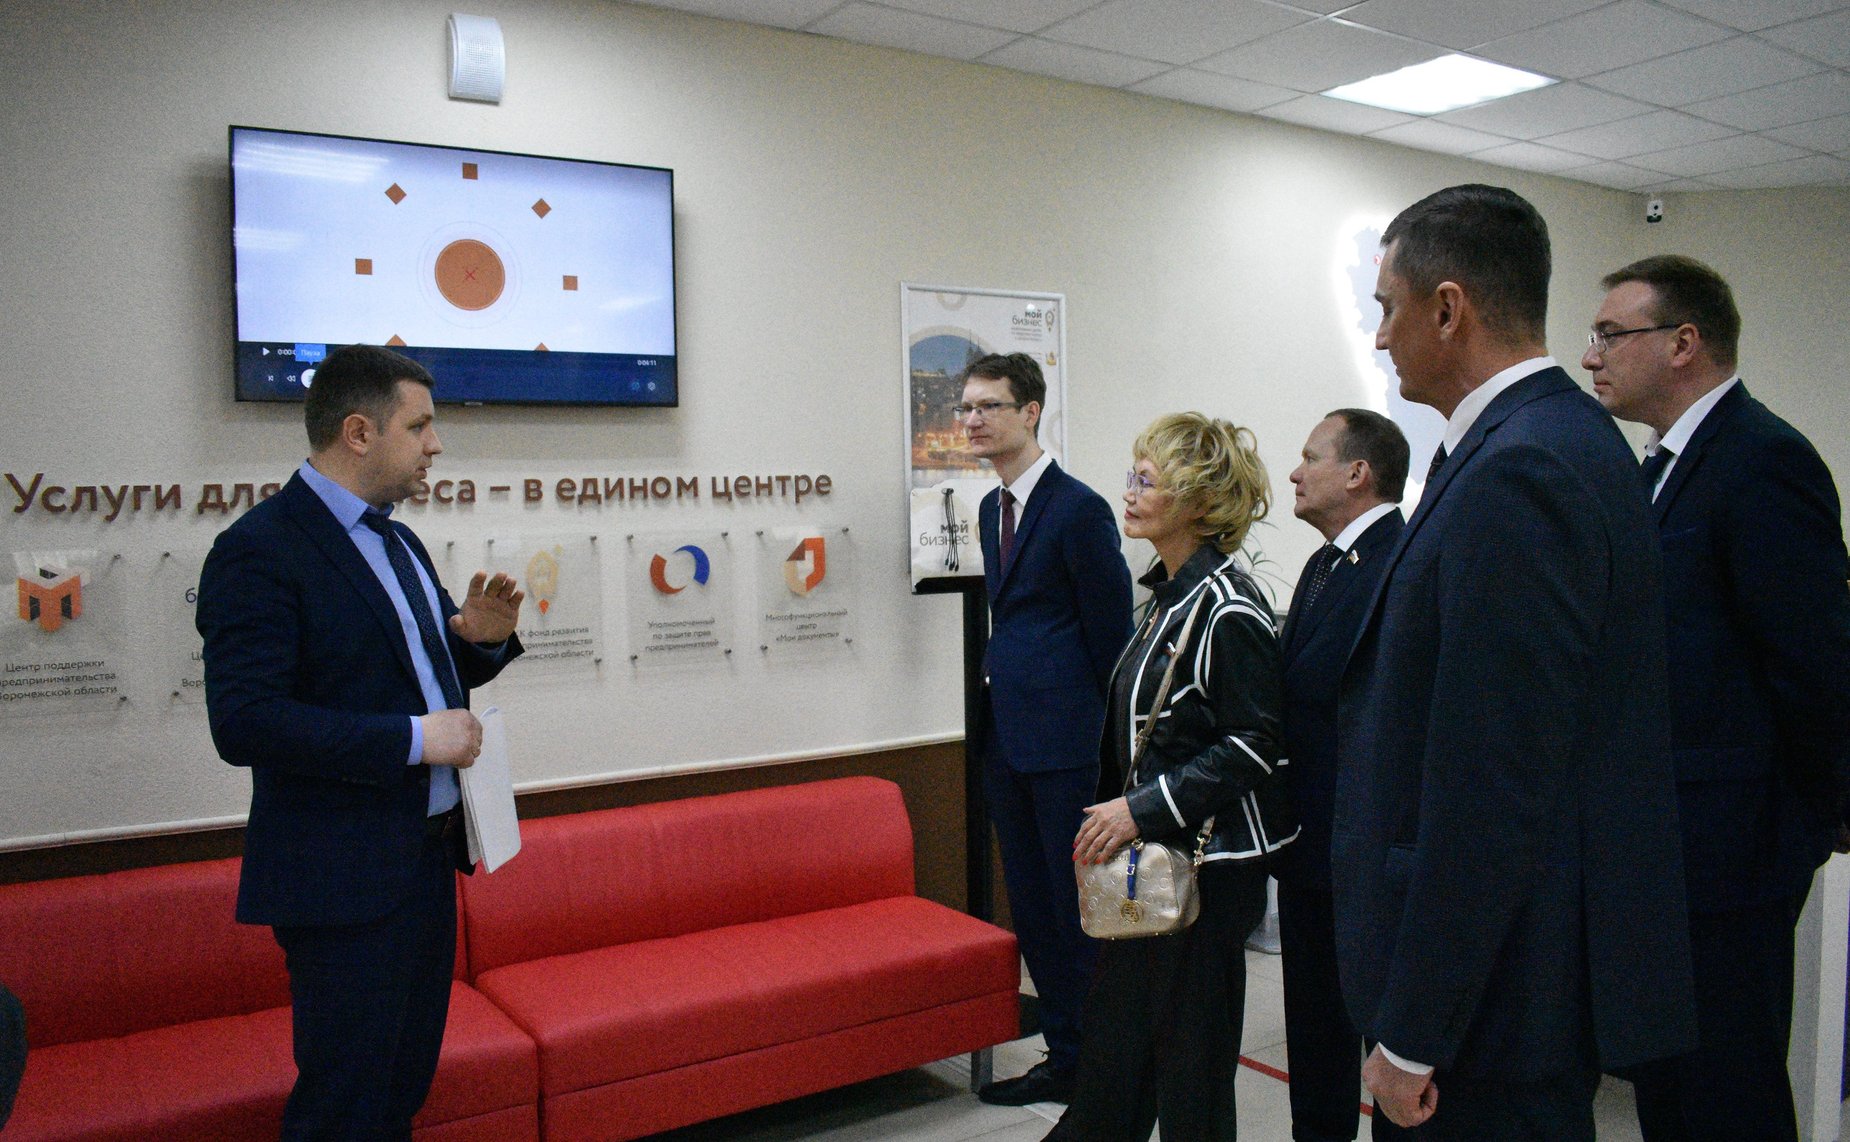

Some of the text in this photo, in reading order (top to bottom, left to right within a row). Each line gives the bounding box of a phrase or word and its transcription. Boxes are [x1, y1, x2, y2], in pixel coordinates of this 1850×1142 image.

[1025, 309, 1042, 318] мой
[1012, 315, 1042, 326] бизнес
[4, 473, 182, 522] Услуги
[524, 479, 543, 502] в
[556, 476, 698, 505] едином
[711, 474, 832, 503] центре
[941, 520, 969, 534] мой
[920, 532, 969, 546] бизнес
[765, 608, 848, 621] Многофункциональный
[647, 617, 715, 628] Уполномоченный
[528, 629, 550, 637] фонд
[552, 627, 589, 636] развития
[665, 631, 692, 639] защите
[522, 639, 593, 650] принимательства
[645, 639, 719, 652] предпринимателей
[561, 649, 594, 658] области
[5, 660, 105, 673] Центр поддержки
[74, 686, 117, 696] области
